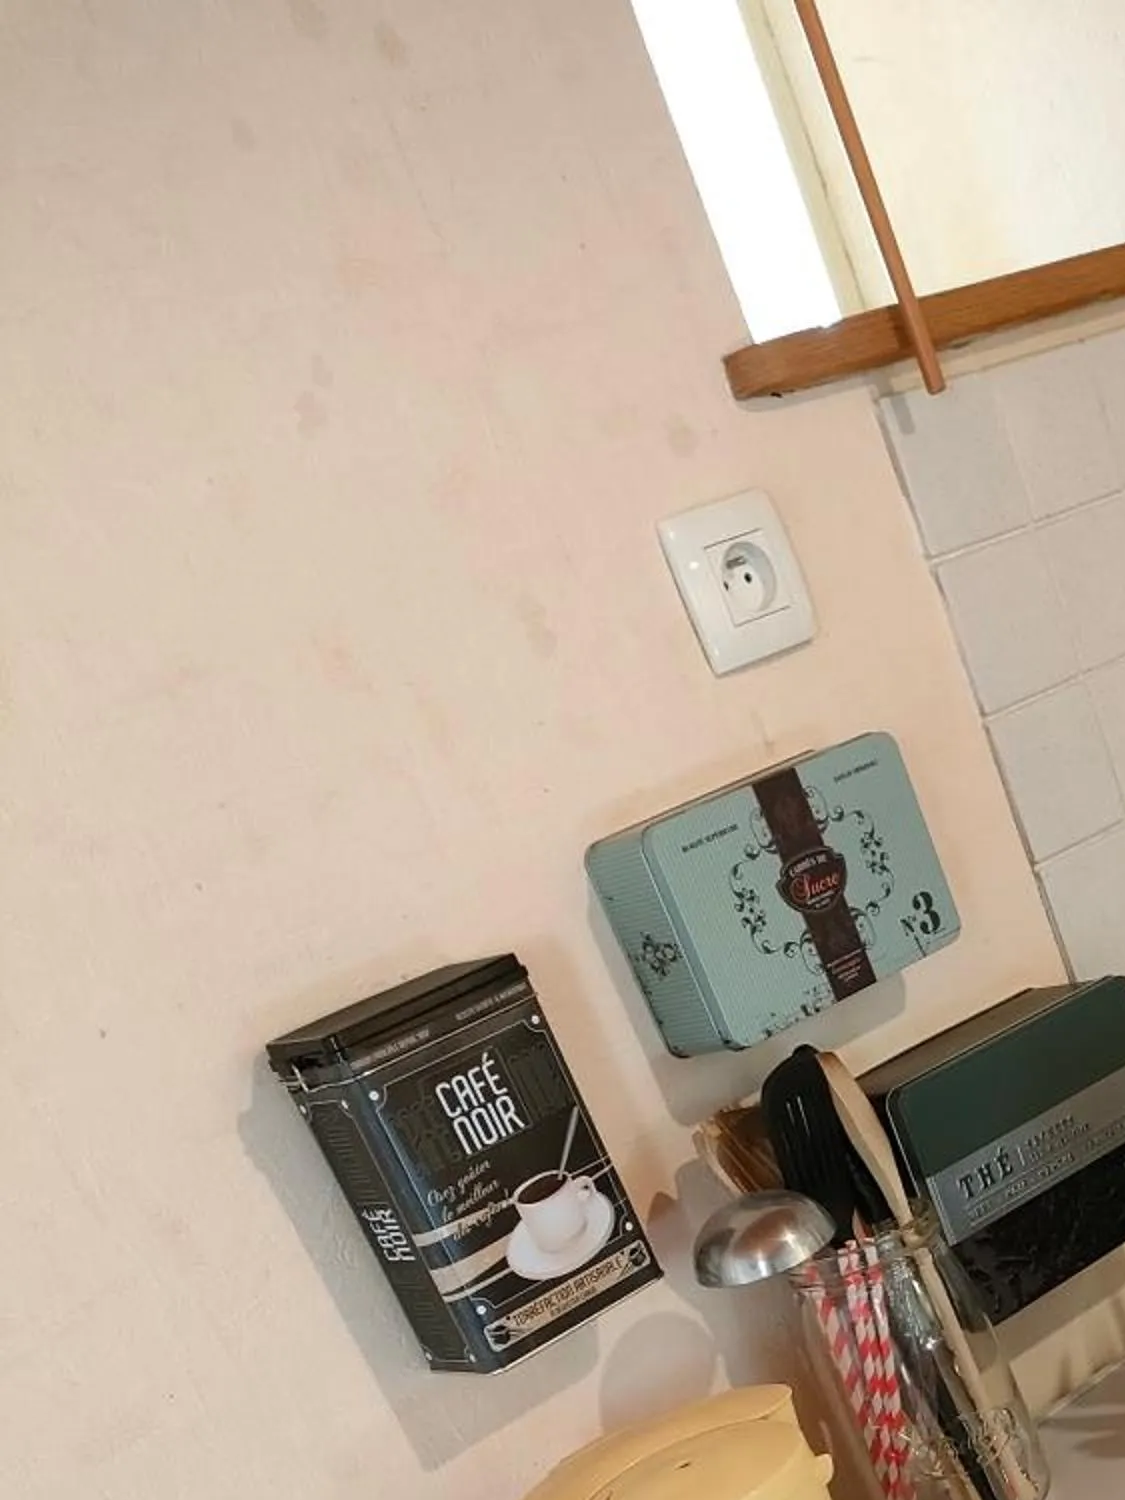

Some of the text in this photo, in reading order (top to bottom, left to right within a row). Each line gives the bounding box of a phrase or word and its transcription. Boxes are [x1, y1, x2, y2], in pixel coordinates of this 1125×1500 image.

[435, 1051, 508, 1118] CAFÉ
[453, 1095, 525, 1155] NOIR
[956, 1145, 1014, 1201] THÉ
